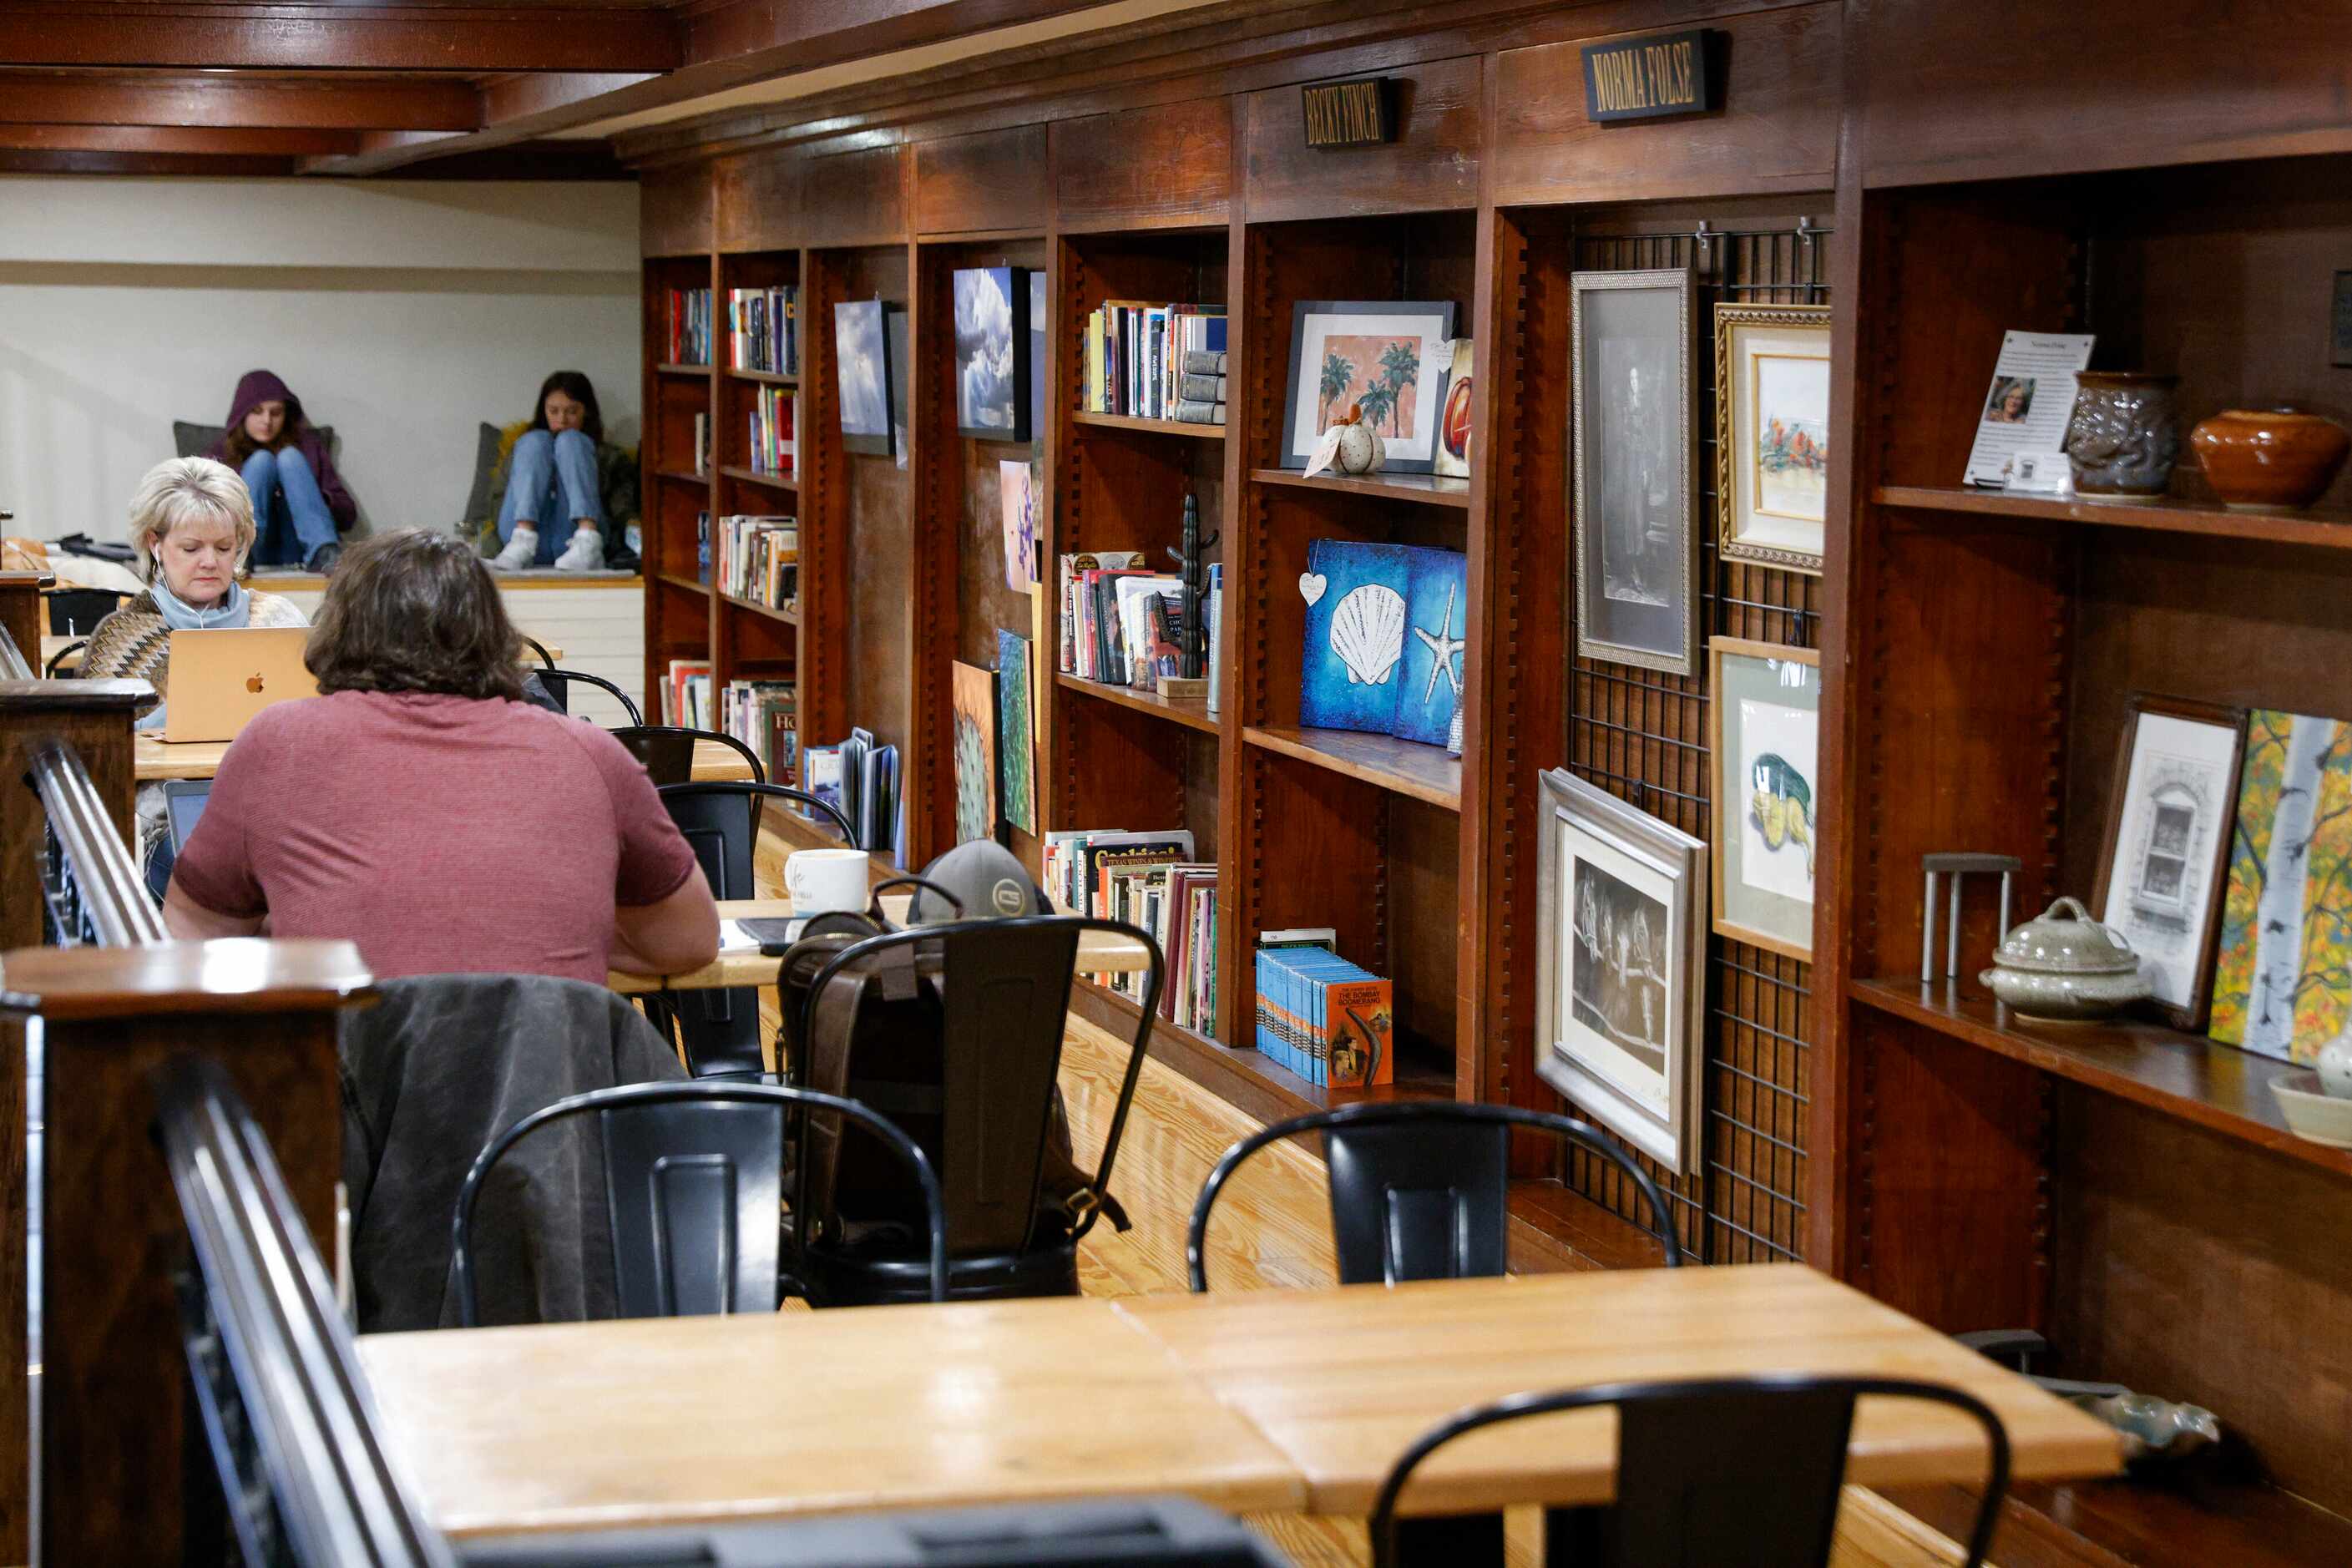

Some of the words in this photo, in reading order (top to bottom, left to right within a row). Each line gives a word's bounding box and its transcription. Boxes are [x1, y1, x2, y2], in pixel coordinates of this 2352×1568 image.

[1591, 48, 1646, 113] NORMA
[1645, 41, 1693, 107] FOLSE
[1304, 86, 1342, 145] BECKY
[1340, 82, 1379, 142] FINCH
